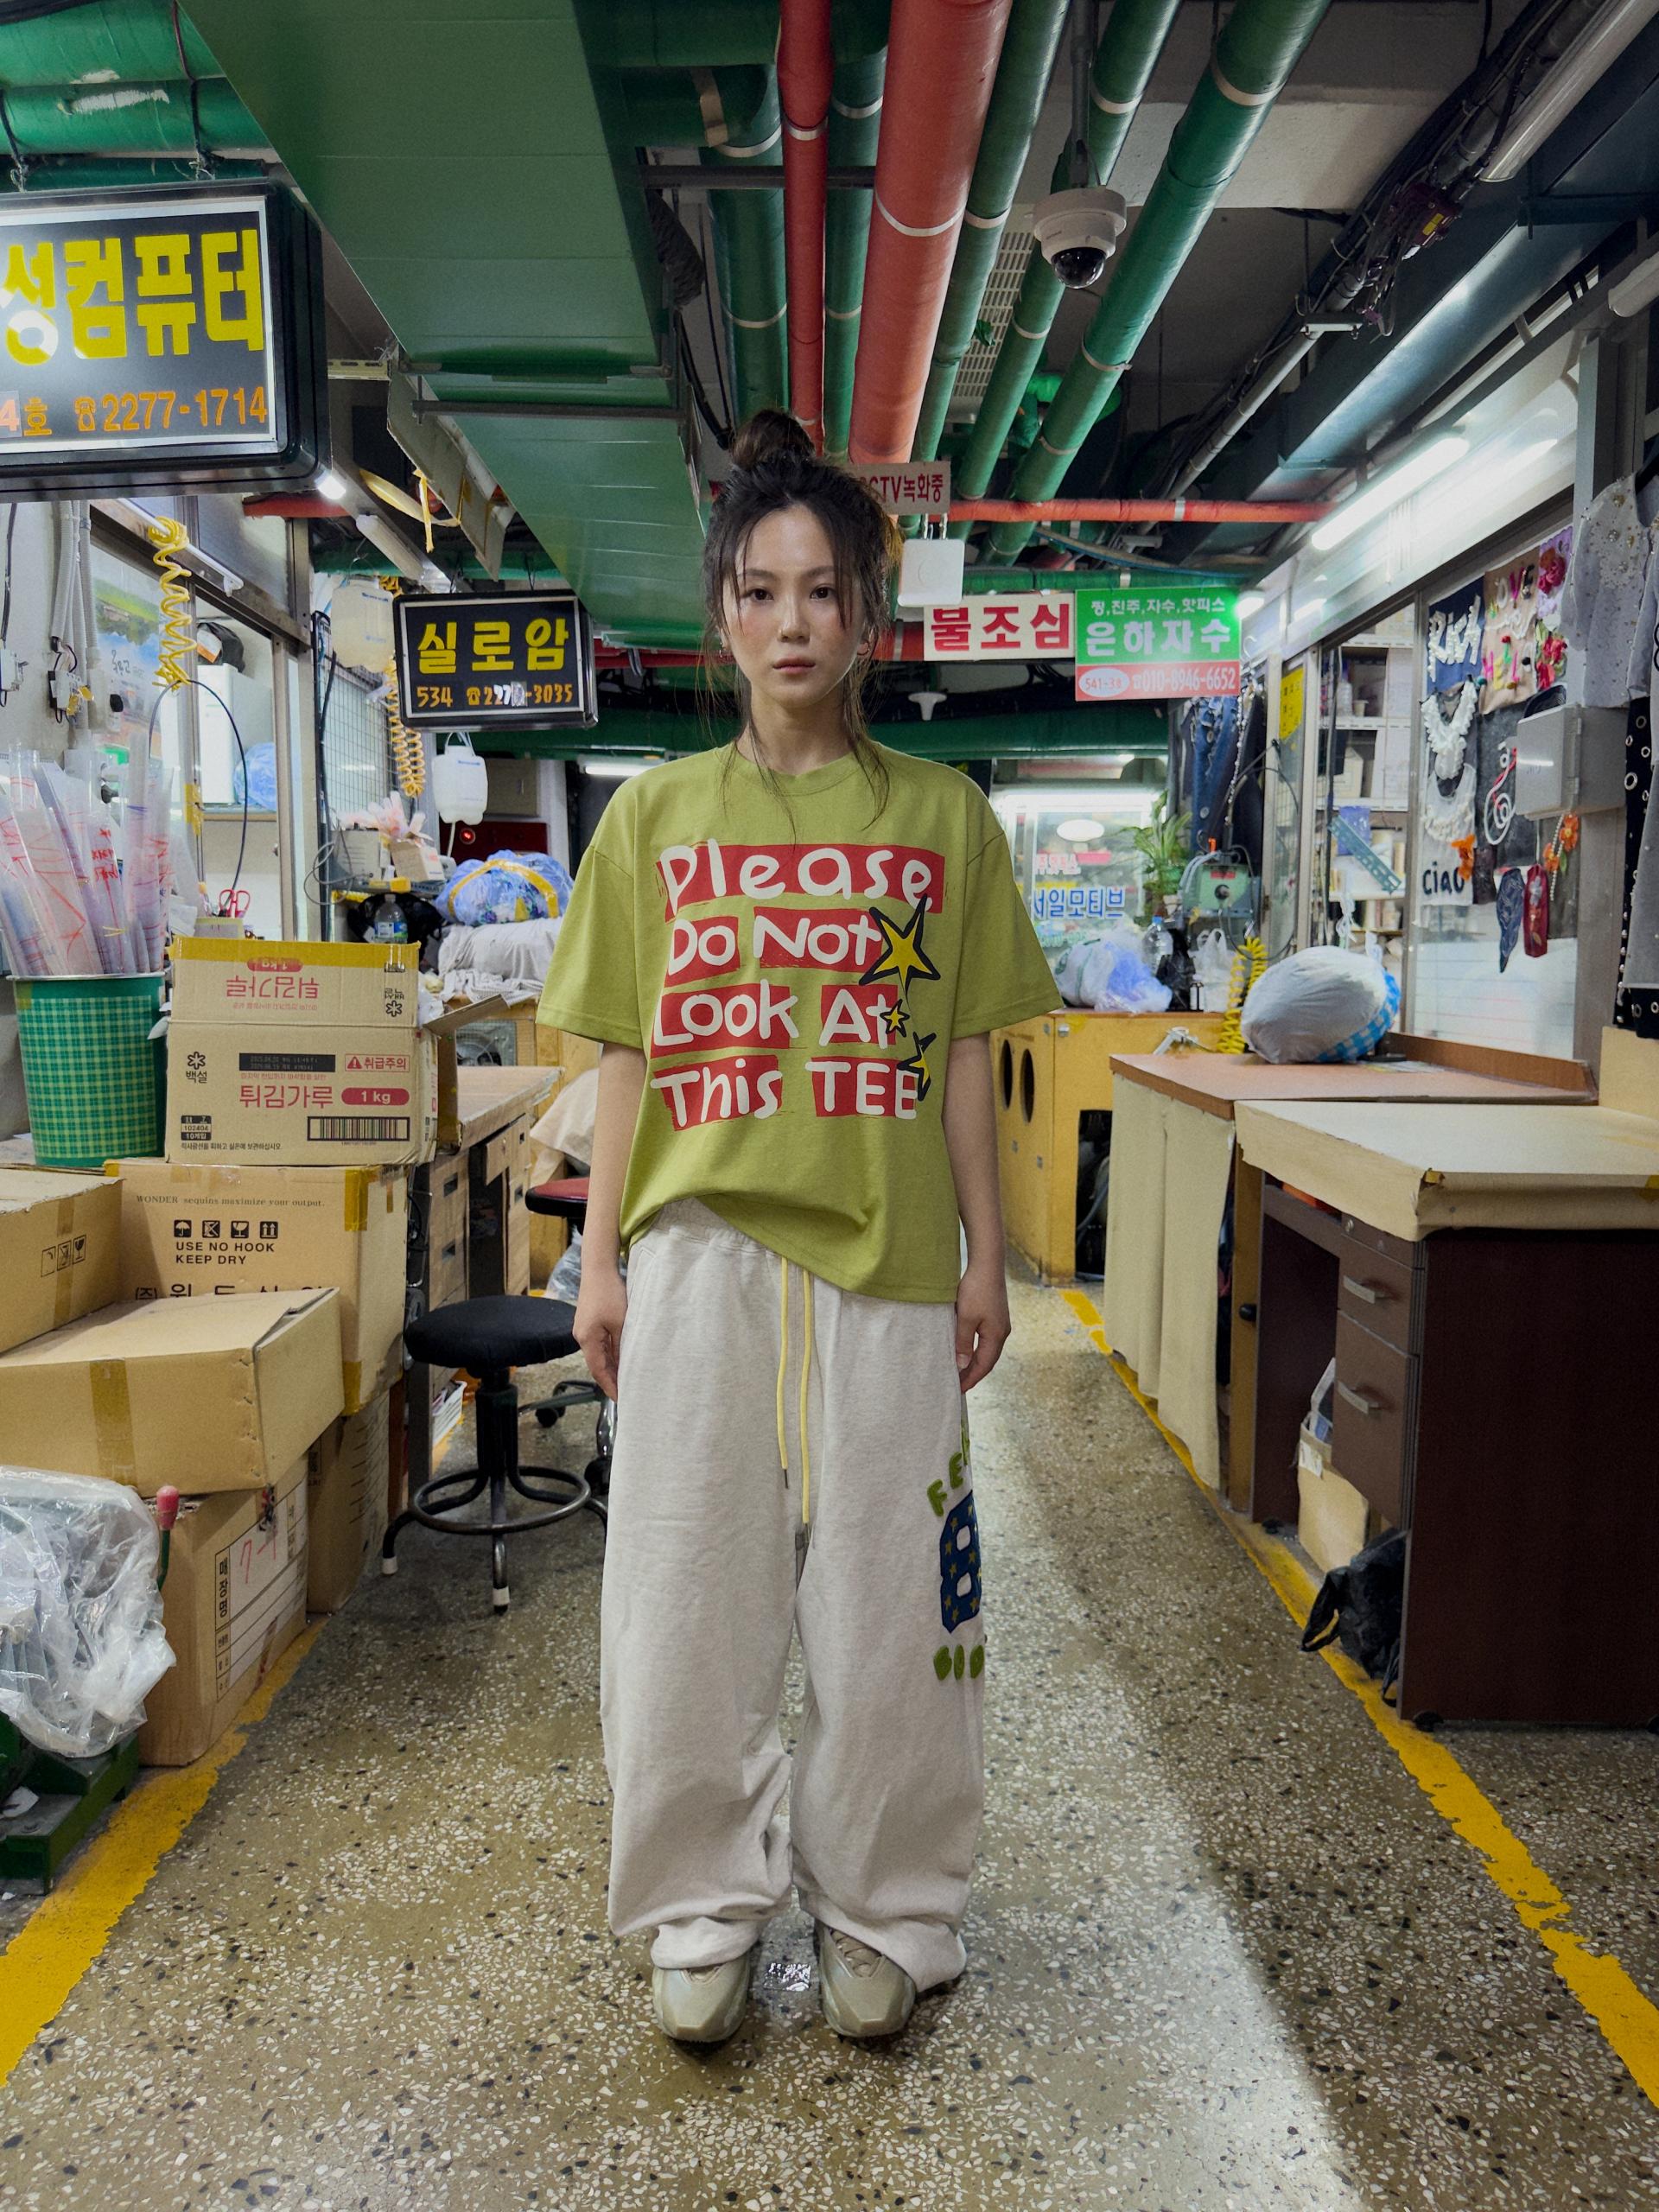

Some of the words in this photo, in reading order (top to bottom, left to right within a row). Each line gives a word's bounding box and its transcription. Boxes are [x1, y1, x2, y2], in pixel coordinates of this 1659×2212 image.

[0, 229, 264, 365] 성컴퓨터
[102, 386, 268, 431] 2277-1714
[861, 474, 943, 503] TV녹화중
[931, 603, 1070, 652] 불조심
[1086, 619, 1231, 657] 은하자수
[417, 618, 569, 674] 실로암
[416, 687, 453, 707] 534
[659, 838, 933, 916] Please
[668, 918, 735, 976] Do
[753, 915, 882, 966] Not
[653, 979, 799, 1046] Look
[819, 989, 893, 1049] At
[186, 1071, 207, 1084] 백설
[364, 1057, 406, 1070] 취급주의
[239, 1085, 333, 1109] 튀김가루
[361, 1091, 367, 1102] 1
[373, 1091, 391, 1104] kg
[651, 1058, 782, 1127] This
[805, 1061, 918, 1120] TEE
[137, 1195, 178, 1204] WONDER
[183, 1197, 218, 1206] sequins
[221, 1197, 266, 1205] maximize
[176, 1242, 203, 1251] USE
[209, 1242, 229, 1251] NO
[234, 1243, 275, 1252] HOOK
[176, 1255, 213, 1264] KEEP
[218, 1255, 247, 1265] DRY
